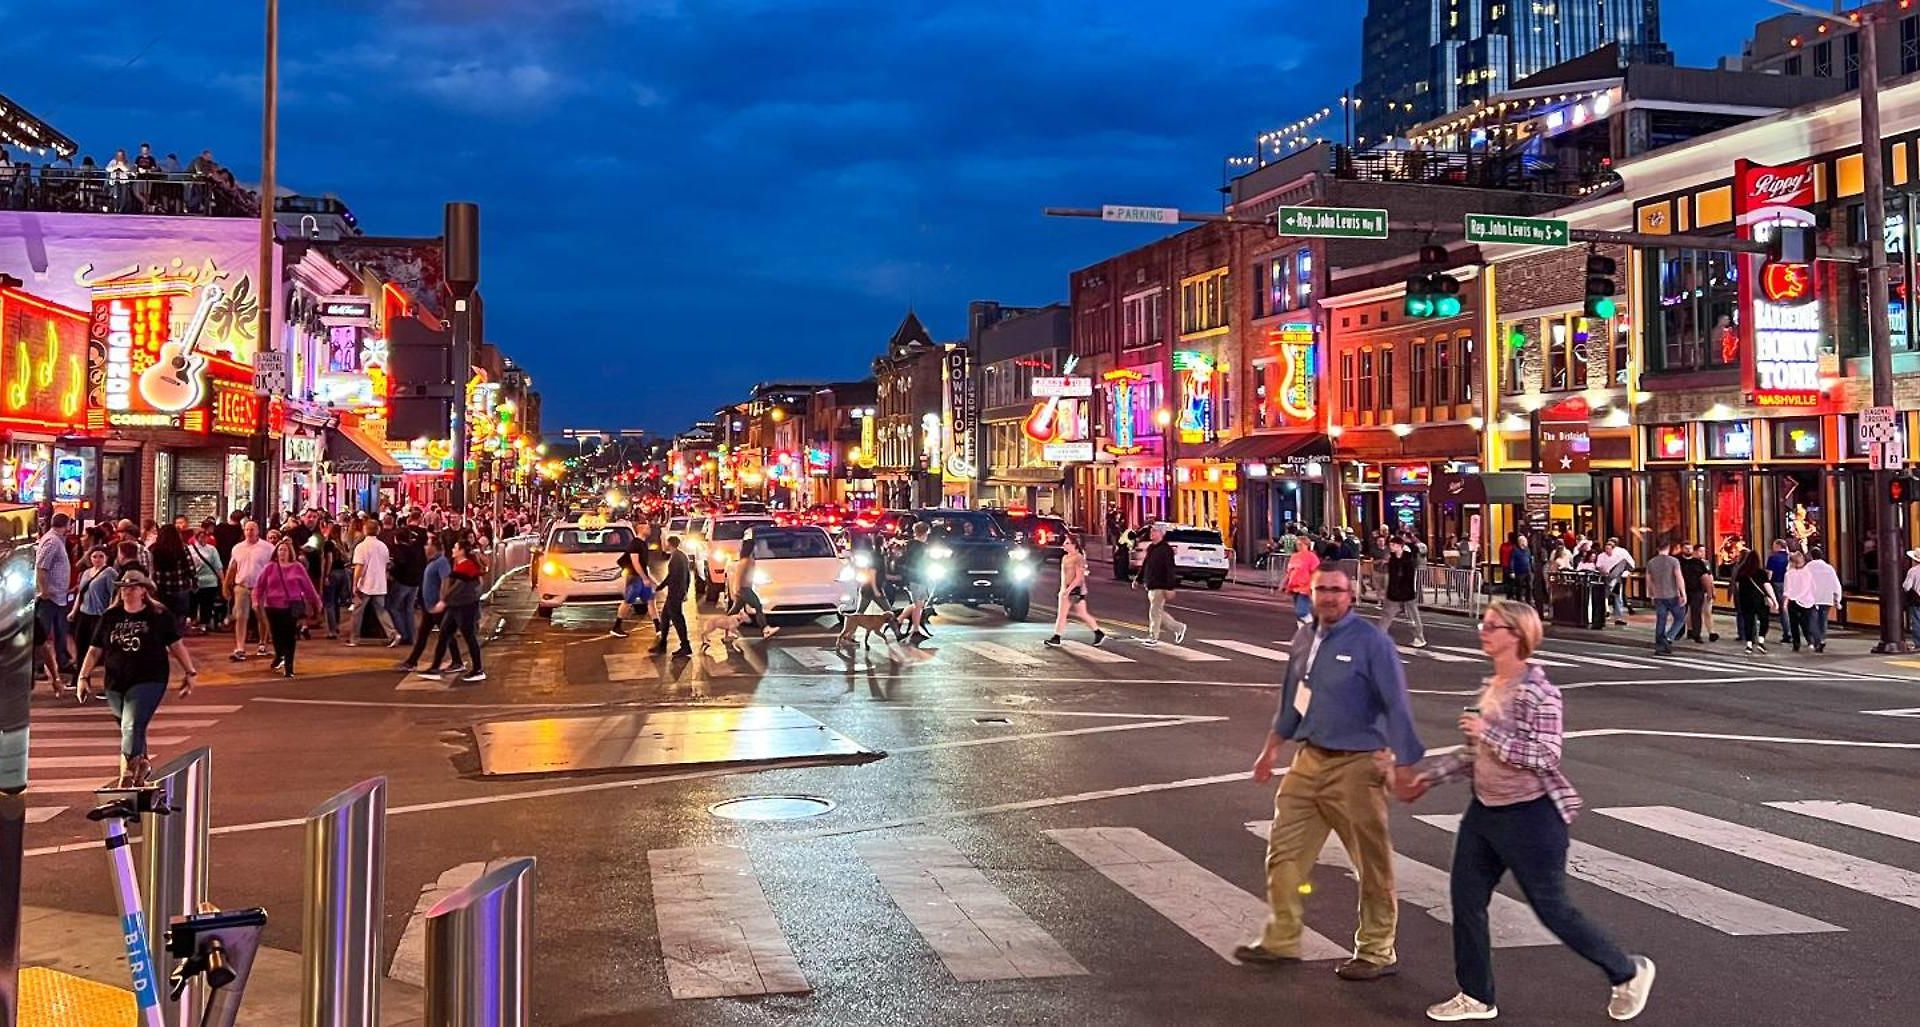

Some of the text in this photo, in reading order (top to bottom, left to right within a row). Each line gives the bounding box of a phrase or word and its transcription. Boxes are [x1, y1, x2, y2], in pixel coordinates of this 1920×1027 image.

[1750, 165, 1813, 199] Rippy's
[1117, 207, 1164, 221] PARKING
[1296, 211, 1382, 232] Rep. John Lewis Way N
[1471, 219, 1552, 240] Rep. John Lewis Way S
[106, 300, 131, 410] LEGENDS
[1757, 331, 1820, 361] HONKY
[255, 374, 267, 389] OK
[1757, 361, 1820, 390] TONK
[952, 355, 964, 457] DOWNTOWN
[1758, 394, 1818, 406] NASHVILLE
[110, 413, 170, 426] CORNER
[1543, 431, 1556, 441] The
[1861, 425, 1876, 438] OK
[125, 931, 147, 991] BIRD
